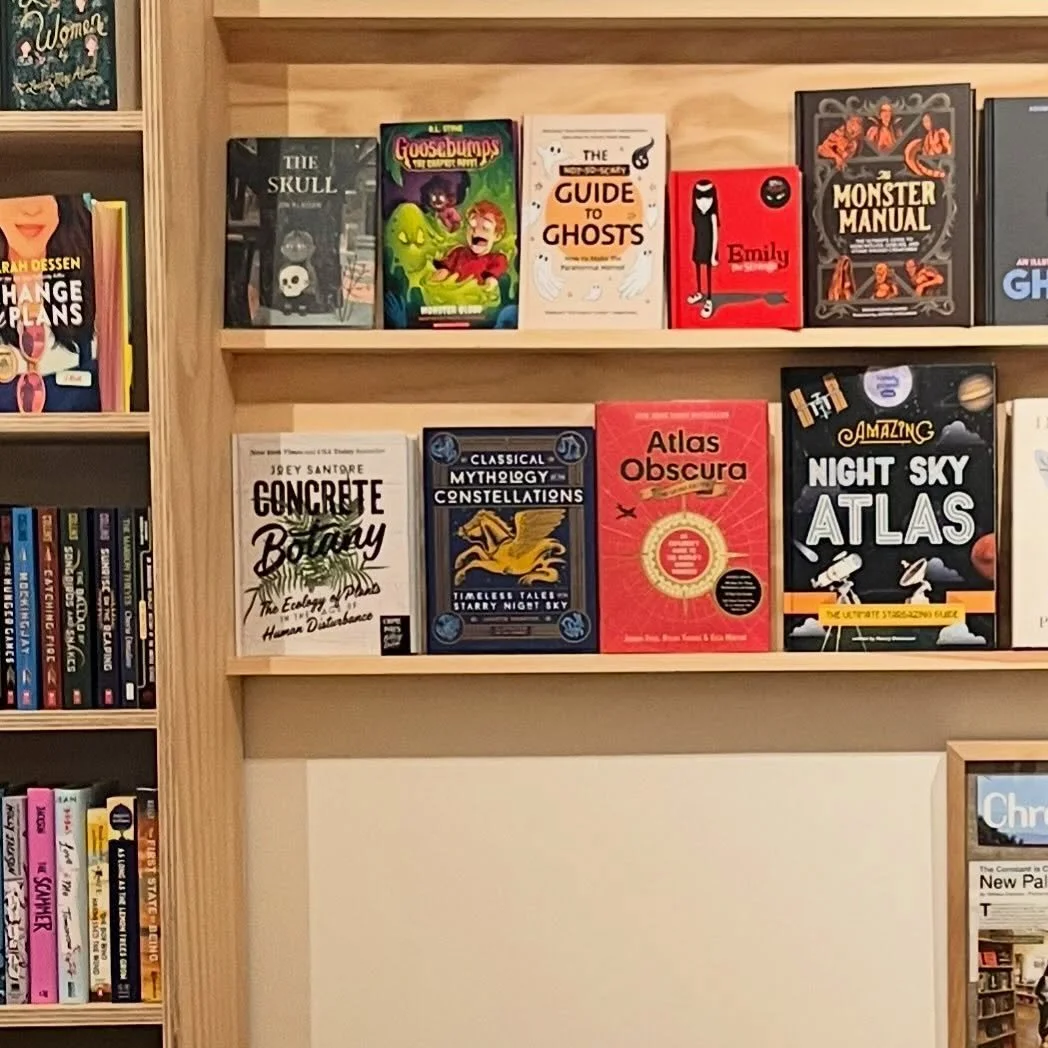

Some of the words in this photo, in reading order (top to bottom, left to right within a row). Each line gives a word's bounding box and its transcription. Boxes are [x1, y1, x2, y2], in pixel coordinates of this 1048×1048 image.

[20, 10, 108, 52] Women
[283, 155, 318, 169] THE
[394, 136, 500, 168] Goosebumps
[583, 150, 608, 161] THE
[267, 176, 338, 194] SKULL
[555, 182, 635, 203] GUIDE
[833, 181, 936, 208] MONSTER
[585, 208, 603, 220] TO
[840, 207, 931, 234] MANUAL
[542, 223, 644, 246] GHOSTS
[31, 257, 81, 272] DESSEN
[727, 242, 789, 269] Emily
[9, 303, 83, 328] PLANS
[646, 430, 720, 454] Atlas
[838, 419, 935, 447] AMAZING
[307, 464, 364, 475] SANTORE
[470, 454, 545, 465] CLASSICAL
[620, 458, 747, 482] Obscura
[808, 456, 895, 487] NIGHT
[909, 455, 969, 485] SKY
[450, 470, 549, 484] MYTHOLOGY
[253, 479, 385, 516] CONCRETE
[434, 489, 584, 504] CONSTELLATIONS
[805, 492, 975, 545] ATLAS
[252, 523, 386, 576] Botany
[100, 548, 110, 592] SUNRISE
[44, 570, 54, 630] CATCHING
[76, 588, 85, 631] BALLAD
[260, 601, 278, 616] The
[282, 594, 326, 613] Ecology
[344, 582, 381, 599] Plants
[453, 592, 513, 600] TIMELESS
[453, 602, 497, 611] STARRY
[503, 602, 539, 610] NIGHT
[545, 601, 568, 609] SKY
[19, 572, 29, 655] MOCKINGJAY
[262, 626, 303, 641] Human
[306, 612, 374, 633] Disturbance
[46, 635, 55, 663] FIRE
[66, 630, 76, 672] SNAKES
[103, 625, 112, 671] REAPING
[59, 841, 74, 865] Love
[117, 848, 126, 858] AS
[146, 840, 157, 873] FIRST
[118, 860, 126, 878] LONG
[980, 875, 1016, 889] New
[118, 880, 126, 890] AS
[118, 892, 126, 905] THE
[147, 878, 157, 914] STATE
[33, 877, 52, 932] SCAMMER
[148, 925, 158, 962] BEING
